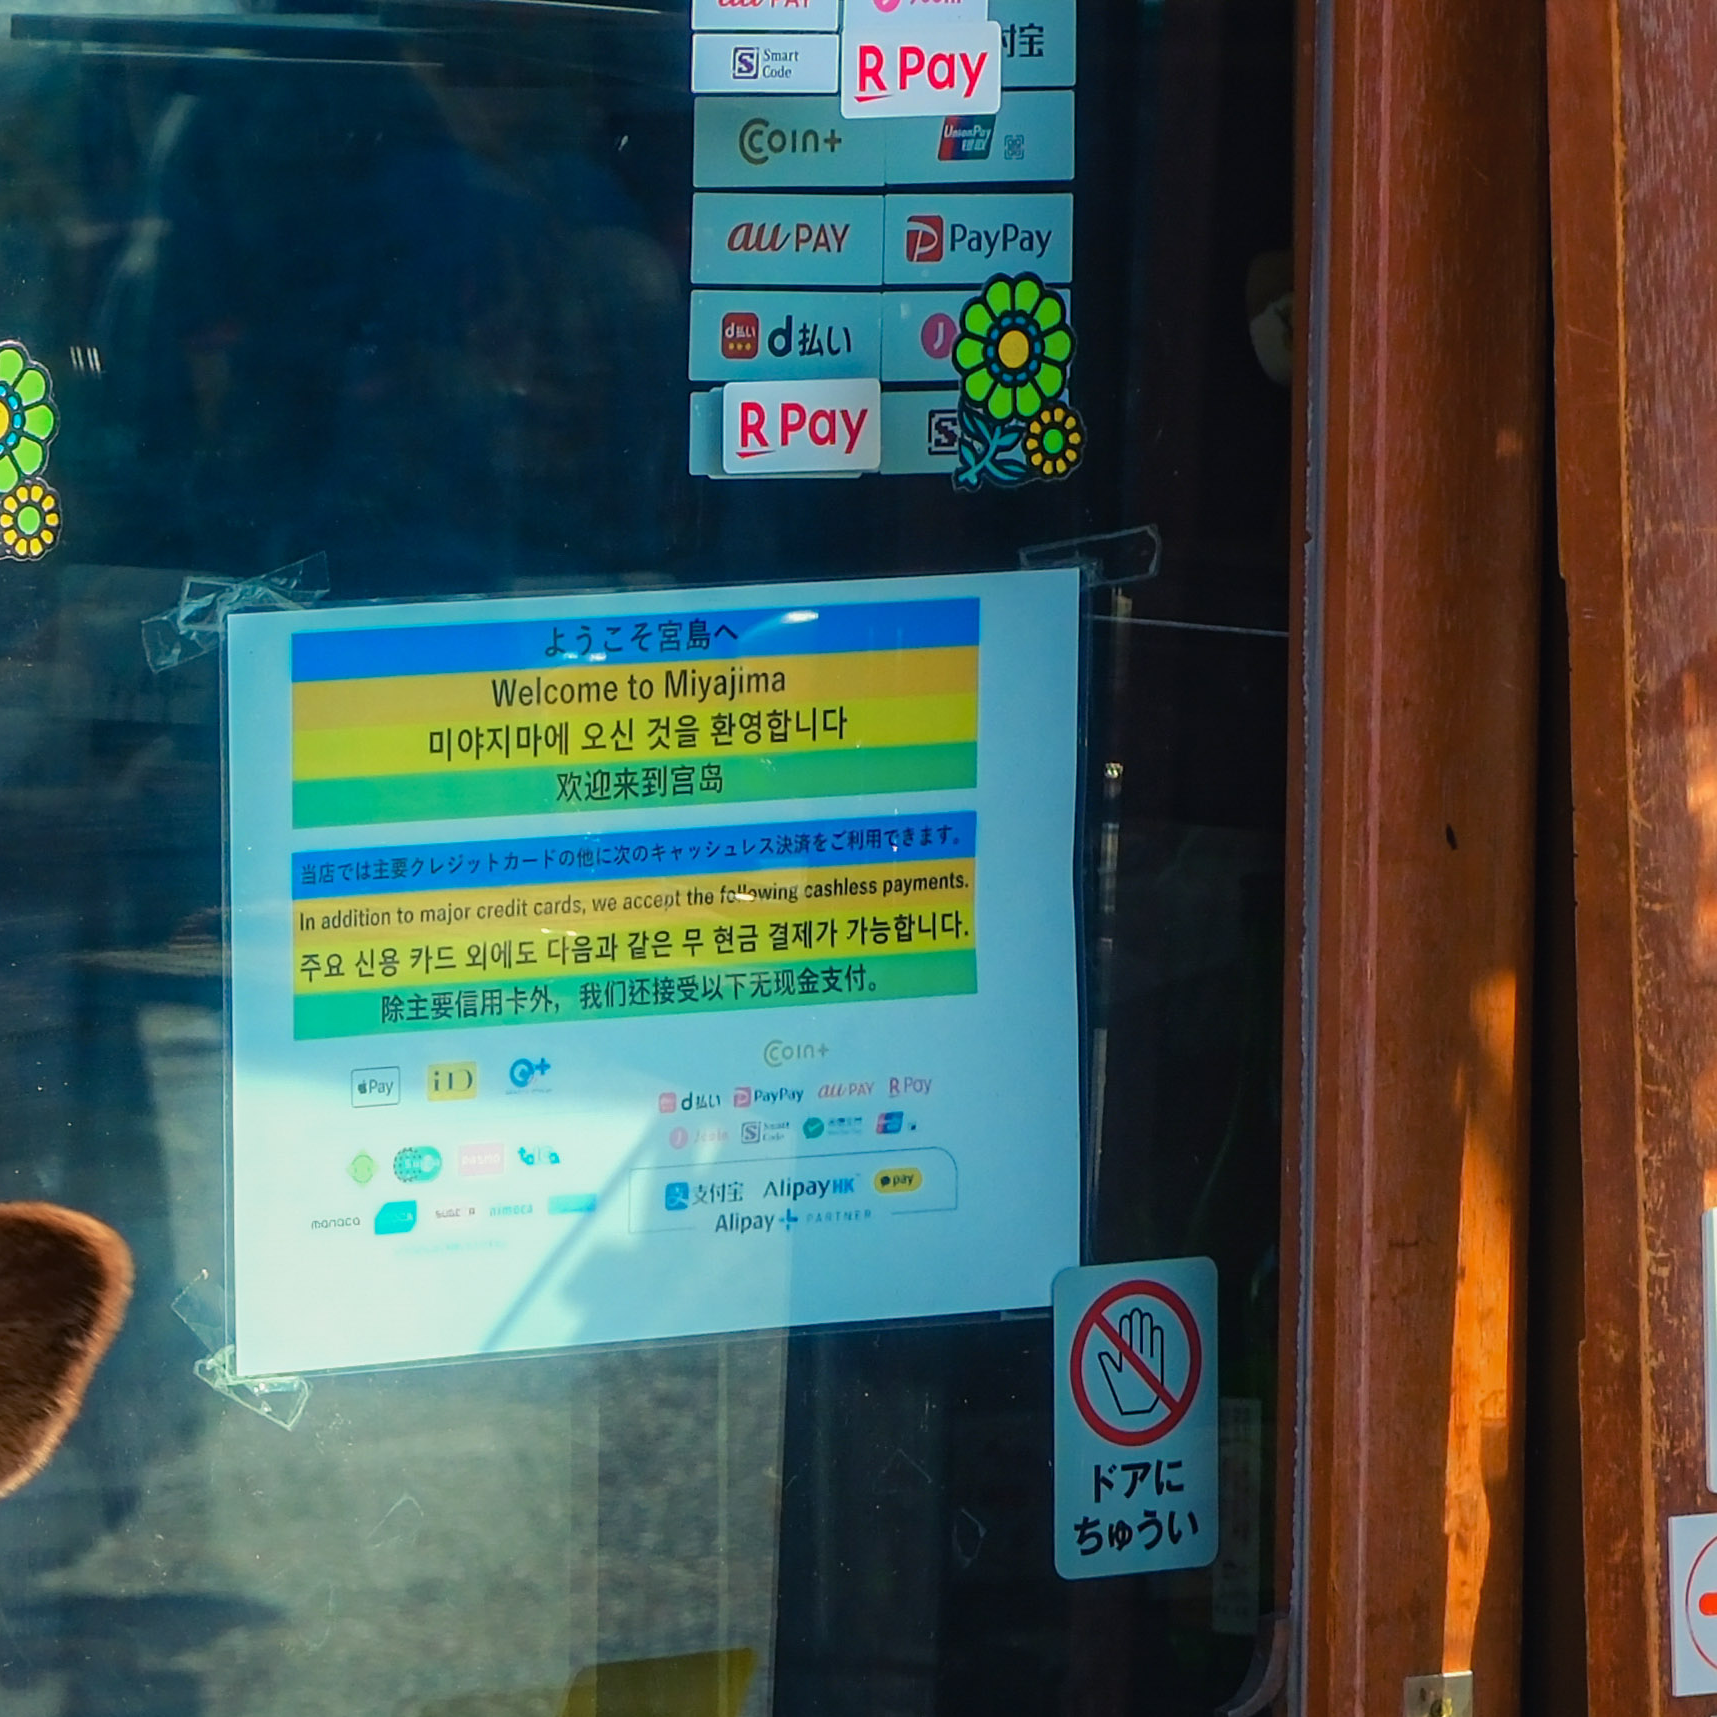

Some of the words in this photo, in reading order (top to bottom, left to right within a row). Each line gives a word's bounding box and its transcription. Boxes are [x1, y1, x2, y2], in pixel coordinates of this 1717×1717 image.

[763, 48, 799, 64] Smart
[763, 64, 792, 80] Code
[899, 45, 988, 99] Pay
[795, 224, 850, 253] PAY
[949, 223, 1053, 259] PayPay
[768, 314, 852, 358] d払い
[780, 402, 868, 454] Pay
[545, 618, 739, 657] ようこそ宮島へ
[492, 676, 618, 708] Welcome
[628, 674, 653, 701] to
[664, 666, 786, 703] Miyajima
[429, 720, 569, 763] 미야지마에
[580, 716, 635, 752] 오신
[646, 714, 701, 750] 것을
[710, 705, 848, 747] 환영합니다
[555, 762, 724, 802] 欢迎来到宫岛
[300, 823, 961, 886] 当店では主要クレジットカードの他に次のキャッシュレス決済をご利用できます。
[299, 912, 316, 931] In
[321, 907, 392, 930] addition
[397, 906, 415, 924] to
[420, 902, 472, 926] major
[476, 898, 528, 921] credit
[533, 894, 587, 916] cards,
[592, 895, 618, 913] we
[622, 889, 682, 912] accept
[686, 886, 715, 907] the
[804, 876, 878, 899] cashless
[882, 871, 970, 898] payments.
[299, 952, 346, 983] 주요
[354, 947, 401, 979] 신용
[409, 944, 458, 975] 카드
[465, 940, 539, 972] 외에도
[547, 932, 619, 967] 다음과
[627, 929, 672, 961] 같은
[682, 928, 705, 957] 무
[713, 924, 759, 954] 현금
[768, 917, 839, 953] 결제가
[846, 910, 970, 946] 가능합니다.
[368, 1078, 394, 1097] Pay
[753, 1087, 804, 1104] PayPay
[849, 1081, 875, 1096] PAY
[903, 1076, 932, 1095] Pay
[692, 1181, 744, 1205] 支付宝
[763, 1176, 855, 1200] AlipayHK
[893, 1173, 915, 1187] pay
[489, 1203, 534, 1217] nimoca
[806, 1210, 872, 1224] PARTNER
[1089, 1459, 1186, 1503] ドアに
[1073, 1509, 1199, 1557] ちゅうい
